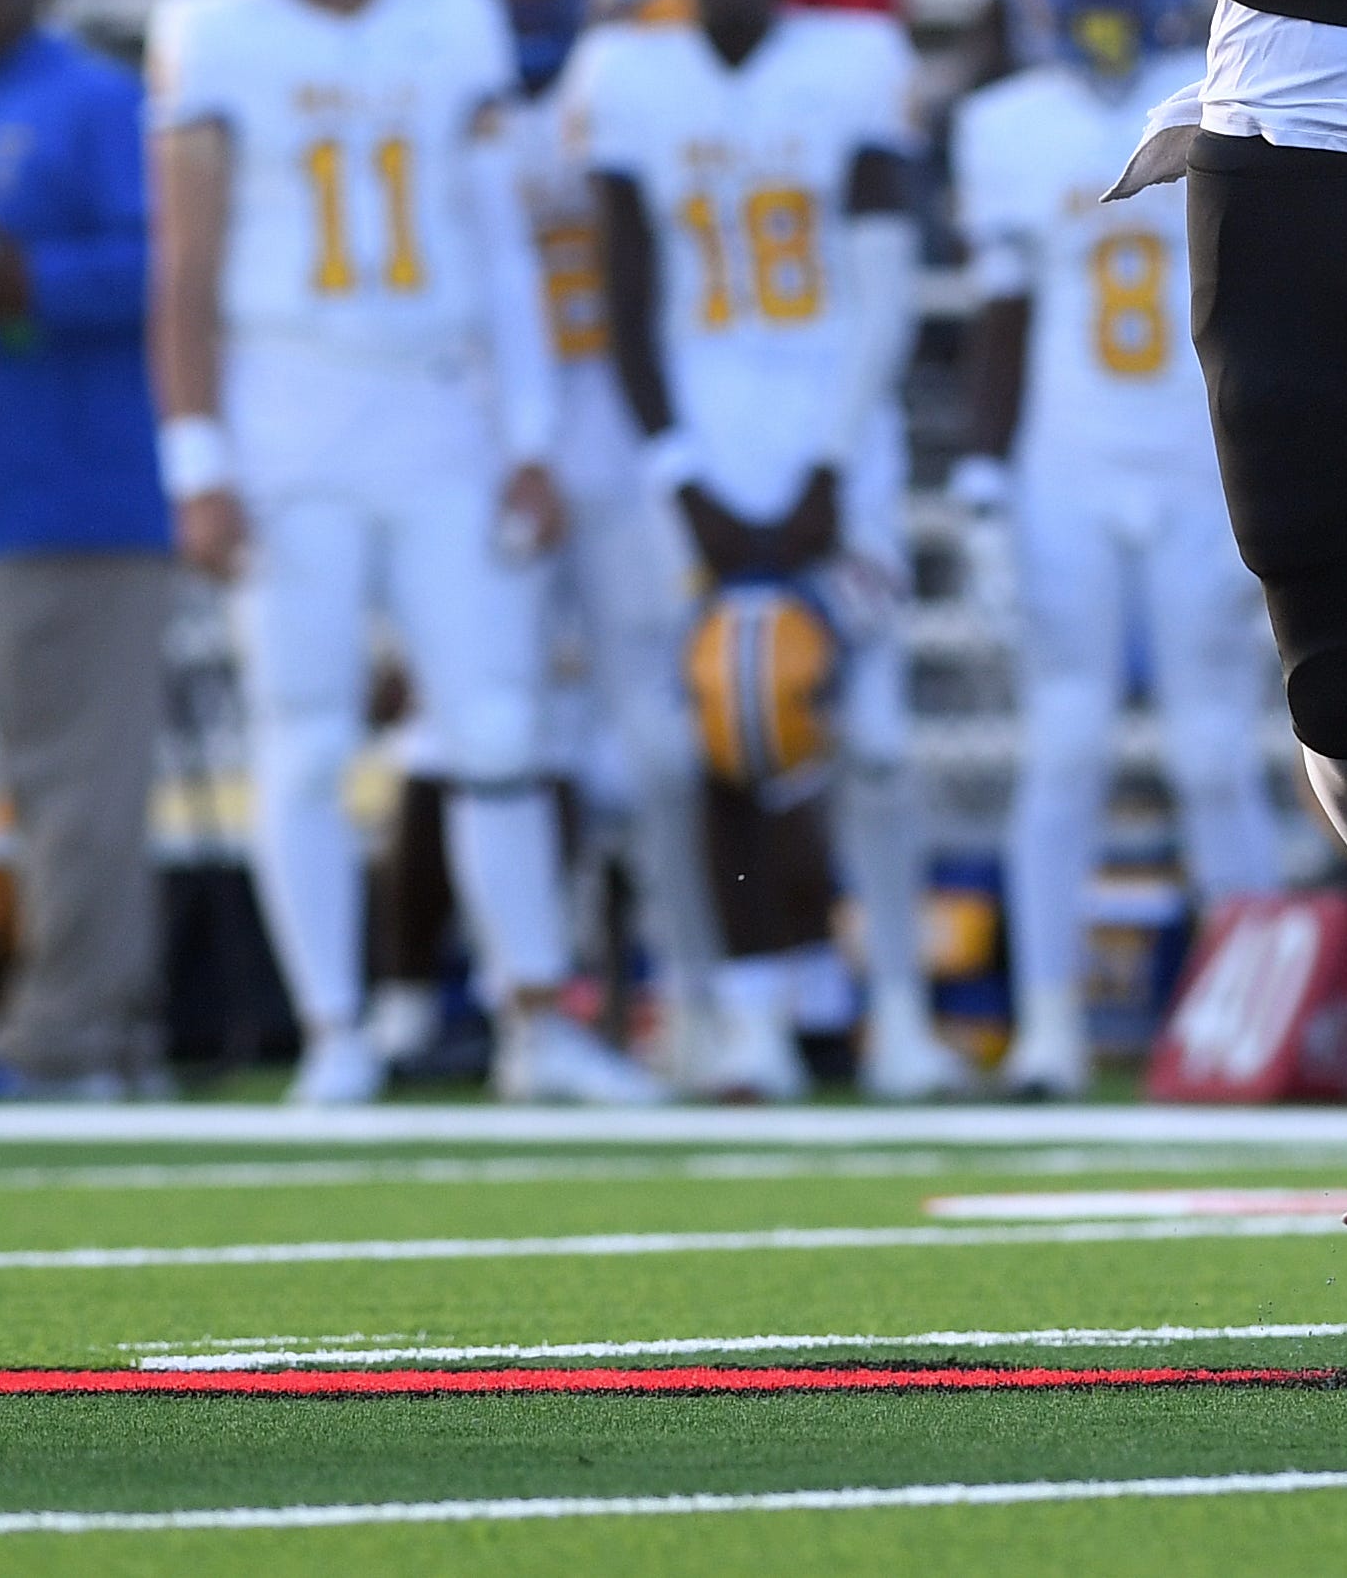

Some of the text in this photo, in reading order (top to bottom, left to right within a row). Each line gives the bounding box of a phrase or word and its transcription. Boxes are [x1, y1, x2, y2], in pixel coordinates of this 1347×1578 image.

[304, 134, 428, 294] 11
[676, 187, 826, 330] 18
[1086, 225, 1172, 380] 8
